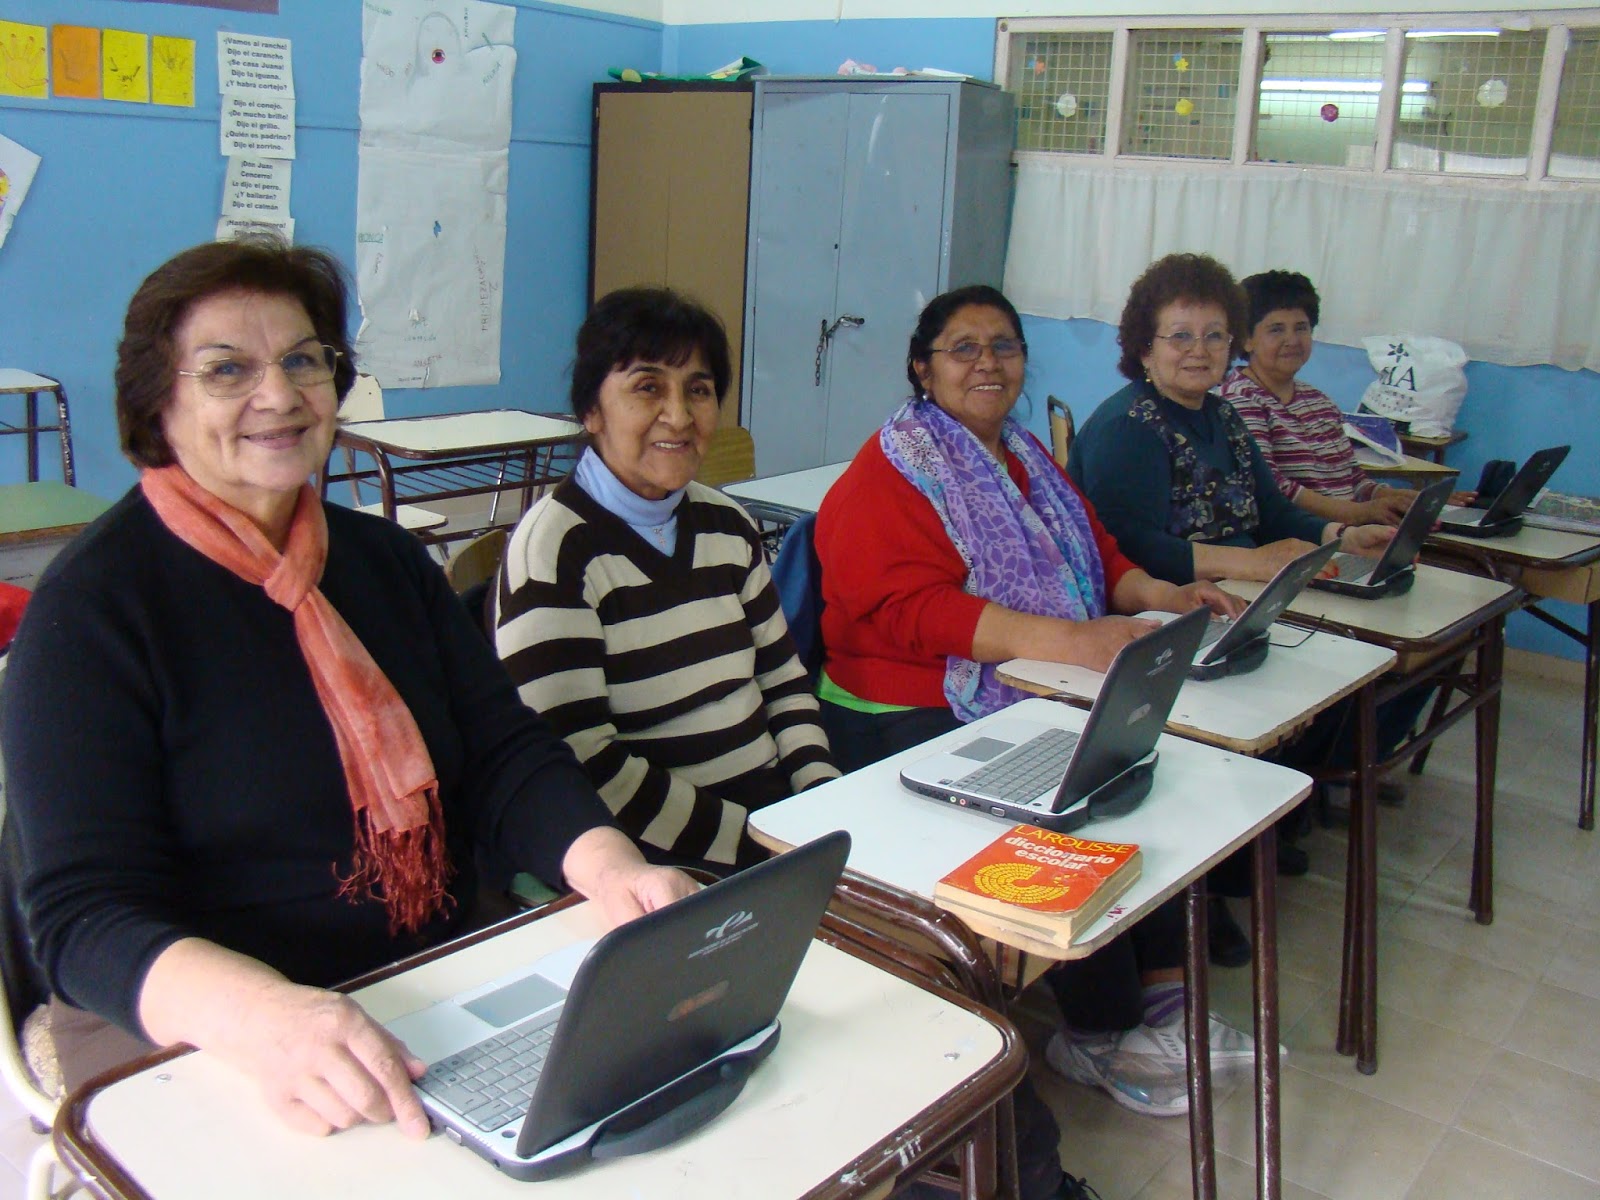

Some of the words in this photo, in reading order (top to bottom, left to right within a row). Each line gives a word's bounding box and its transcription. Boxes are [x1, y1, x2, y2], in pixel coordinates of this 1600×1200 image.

[228, 48, 241, 56] Dijo
[241, 171, 272, 179] Cencerro!
[1014, 824, 1129, 854] LAROUSSE
[1004, 836, 1115, 864] diccionario
[1015, 849, 1087, 870] escolar
